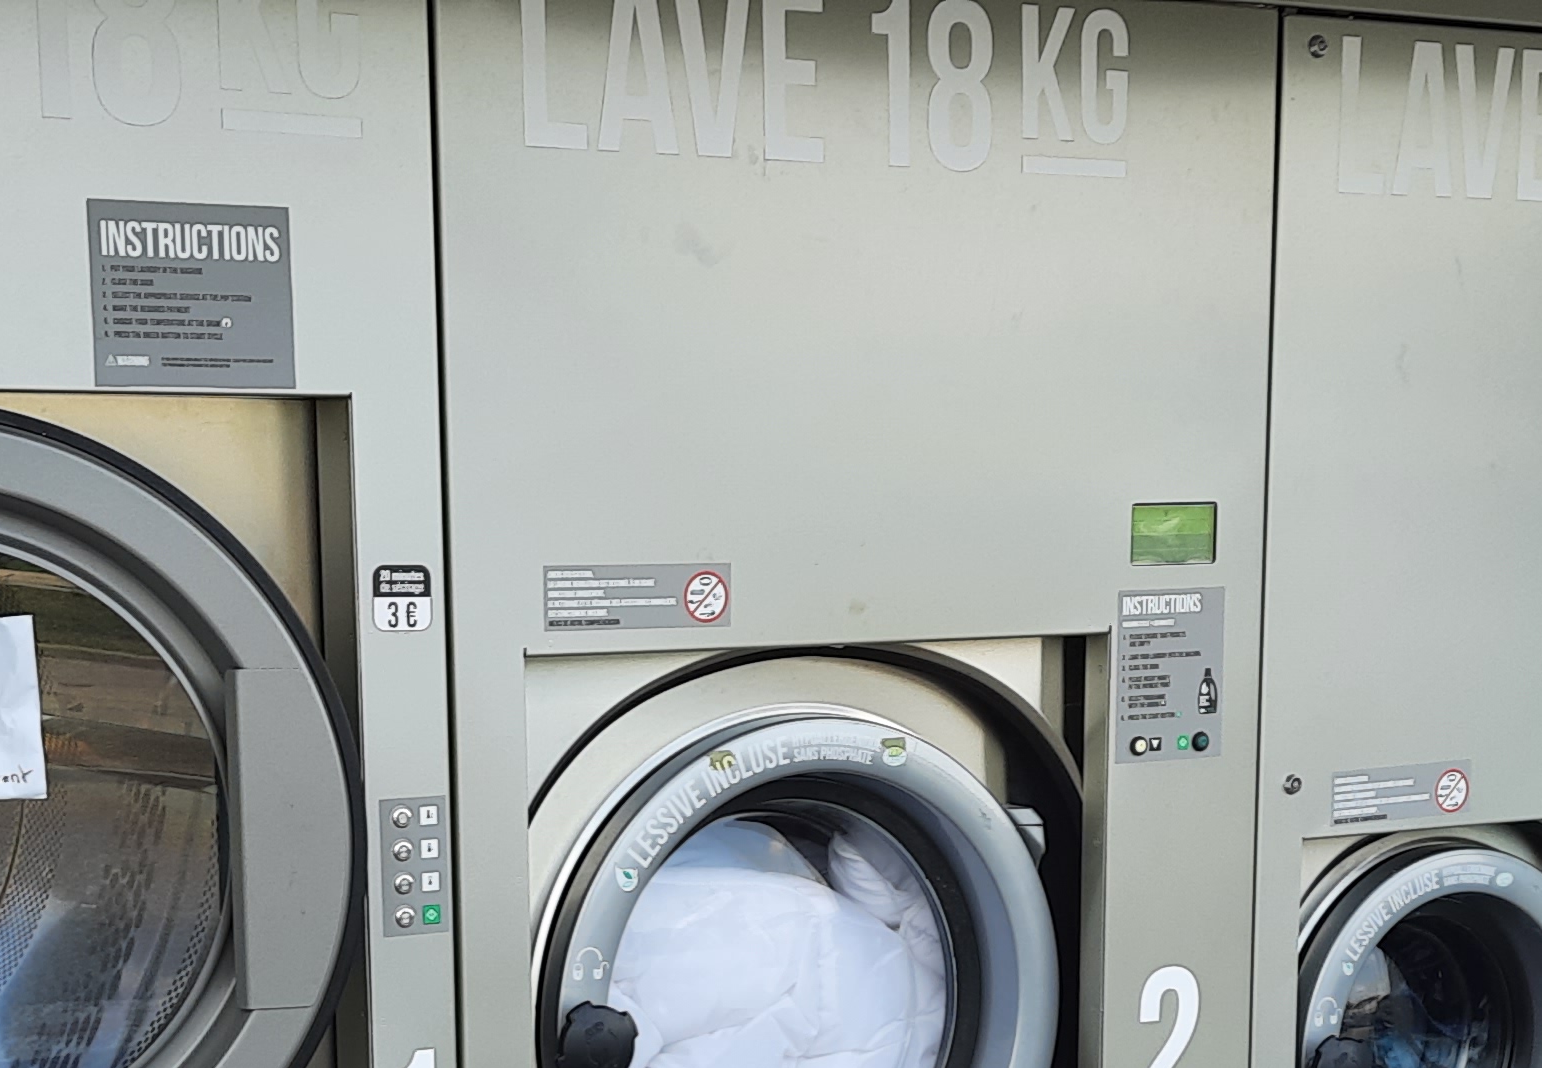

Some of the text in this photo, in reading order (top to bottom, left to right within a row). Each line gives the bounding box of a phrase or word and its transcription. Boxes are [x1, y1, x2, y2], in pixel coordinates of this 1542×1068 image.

[521, 0, 1130, 172] LAVE 18 KG
[99, 219, 281, 263] INSTRUCTIONS
[387, 601, 418, 629] 3 €
[1121, 593, 1202, 615] INSTRUCTIONS
[793, 746, 874, 765] SANS PHOSPHATE
[630, 735, 791, 870] LESSIVE INCLUSE
[1345, 868, 1440, 963] LESSIVE INCLUSE
